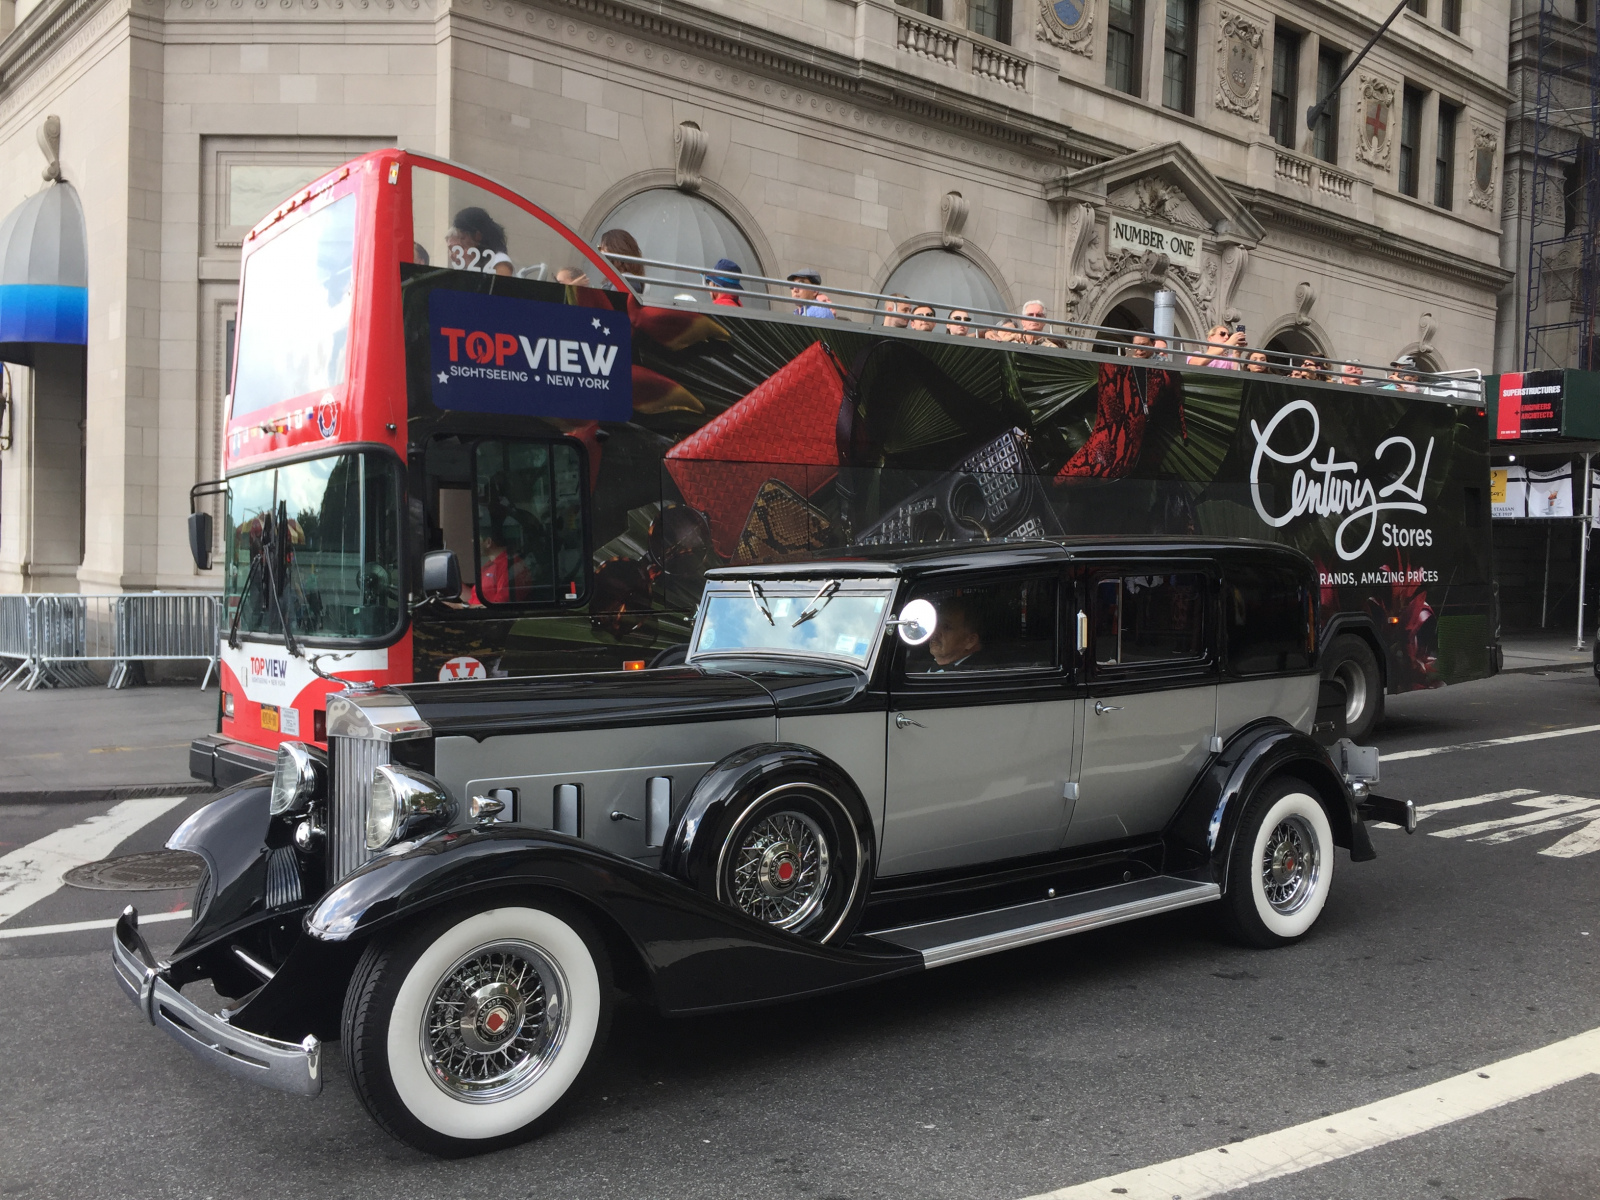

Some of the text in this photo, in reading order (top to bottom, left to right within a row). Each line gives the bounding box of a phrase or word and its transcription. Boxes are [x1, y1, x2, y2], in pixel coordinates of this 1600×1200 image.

[1115, 222, 1194, 258] NUMBER ONE
[451, 245, 497, 274] 322
[441, 327, 618, 377] TOPVIEW
[450, 365, 610, 391] SIGHTSEEING NEW YORK
[1503, 385, 1561, 397] SUPERSTRUCTURES
[1250, 399, 1435, 561] Century 21
[1382, 523, 1433, 547] Stores
[1320, 570, 1439, 586] RANDS, AMAZING PRICES
[250, 657, 287, 679] TOPVIEW
